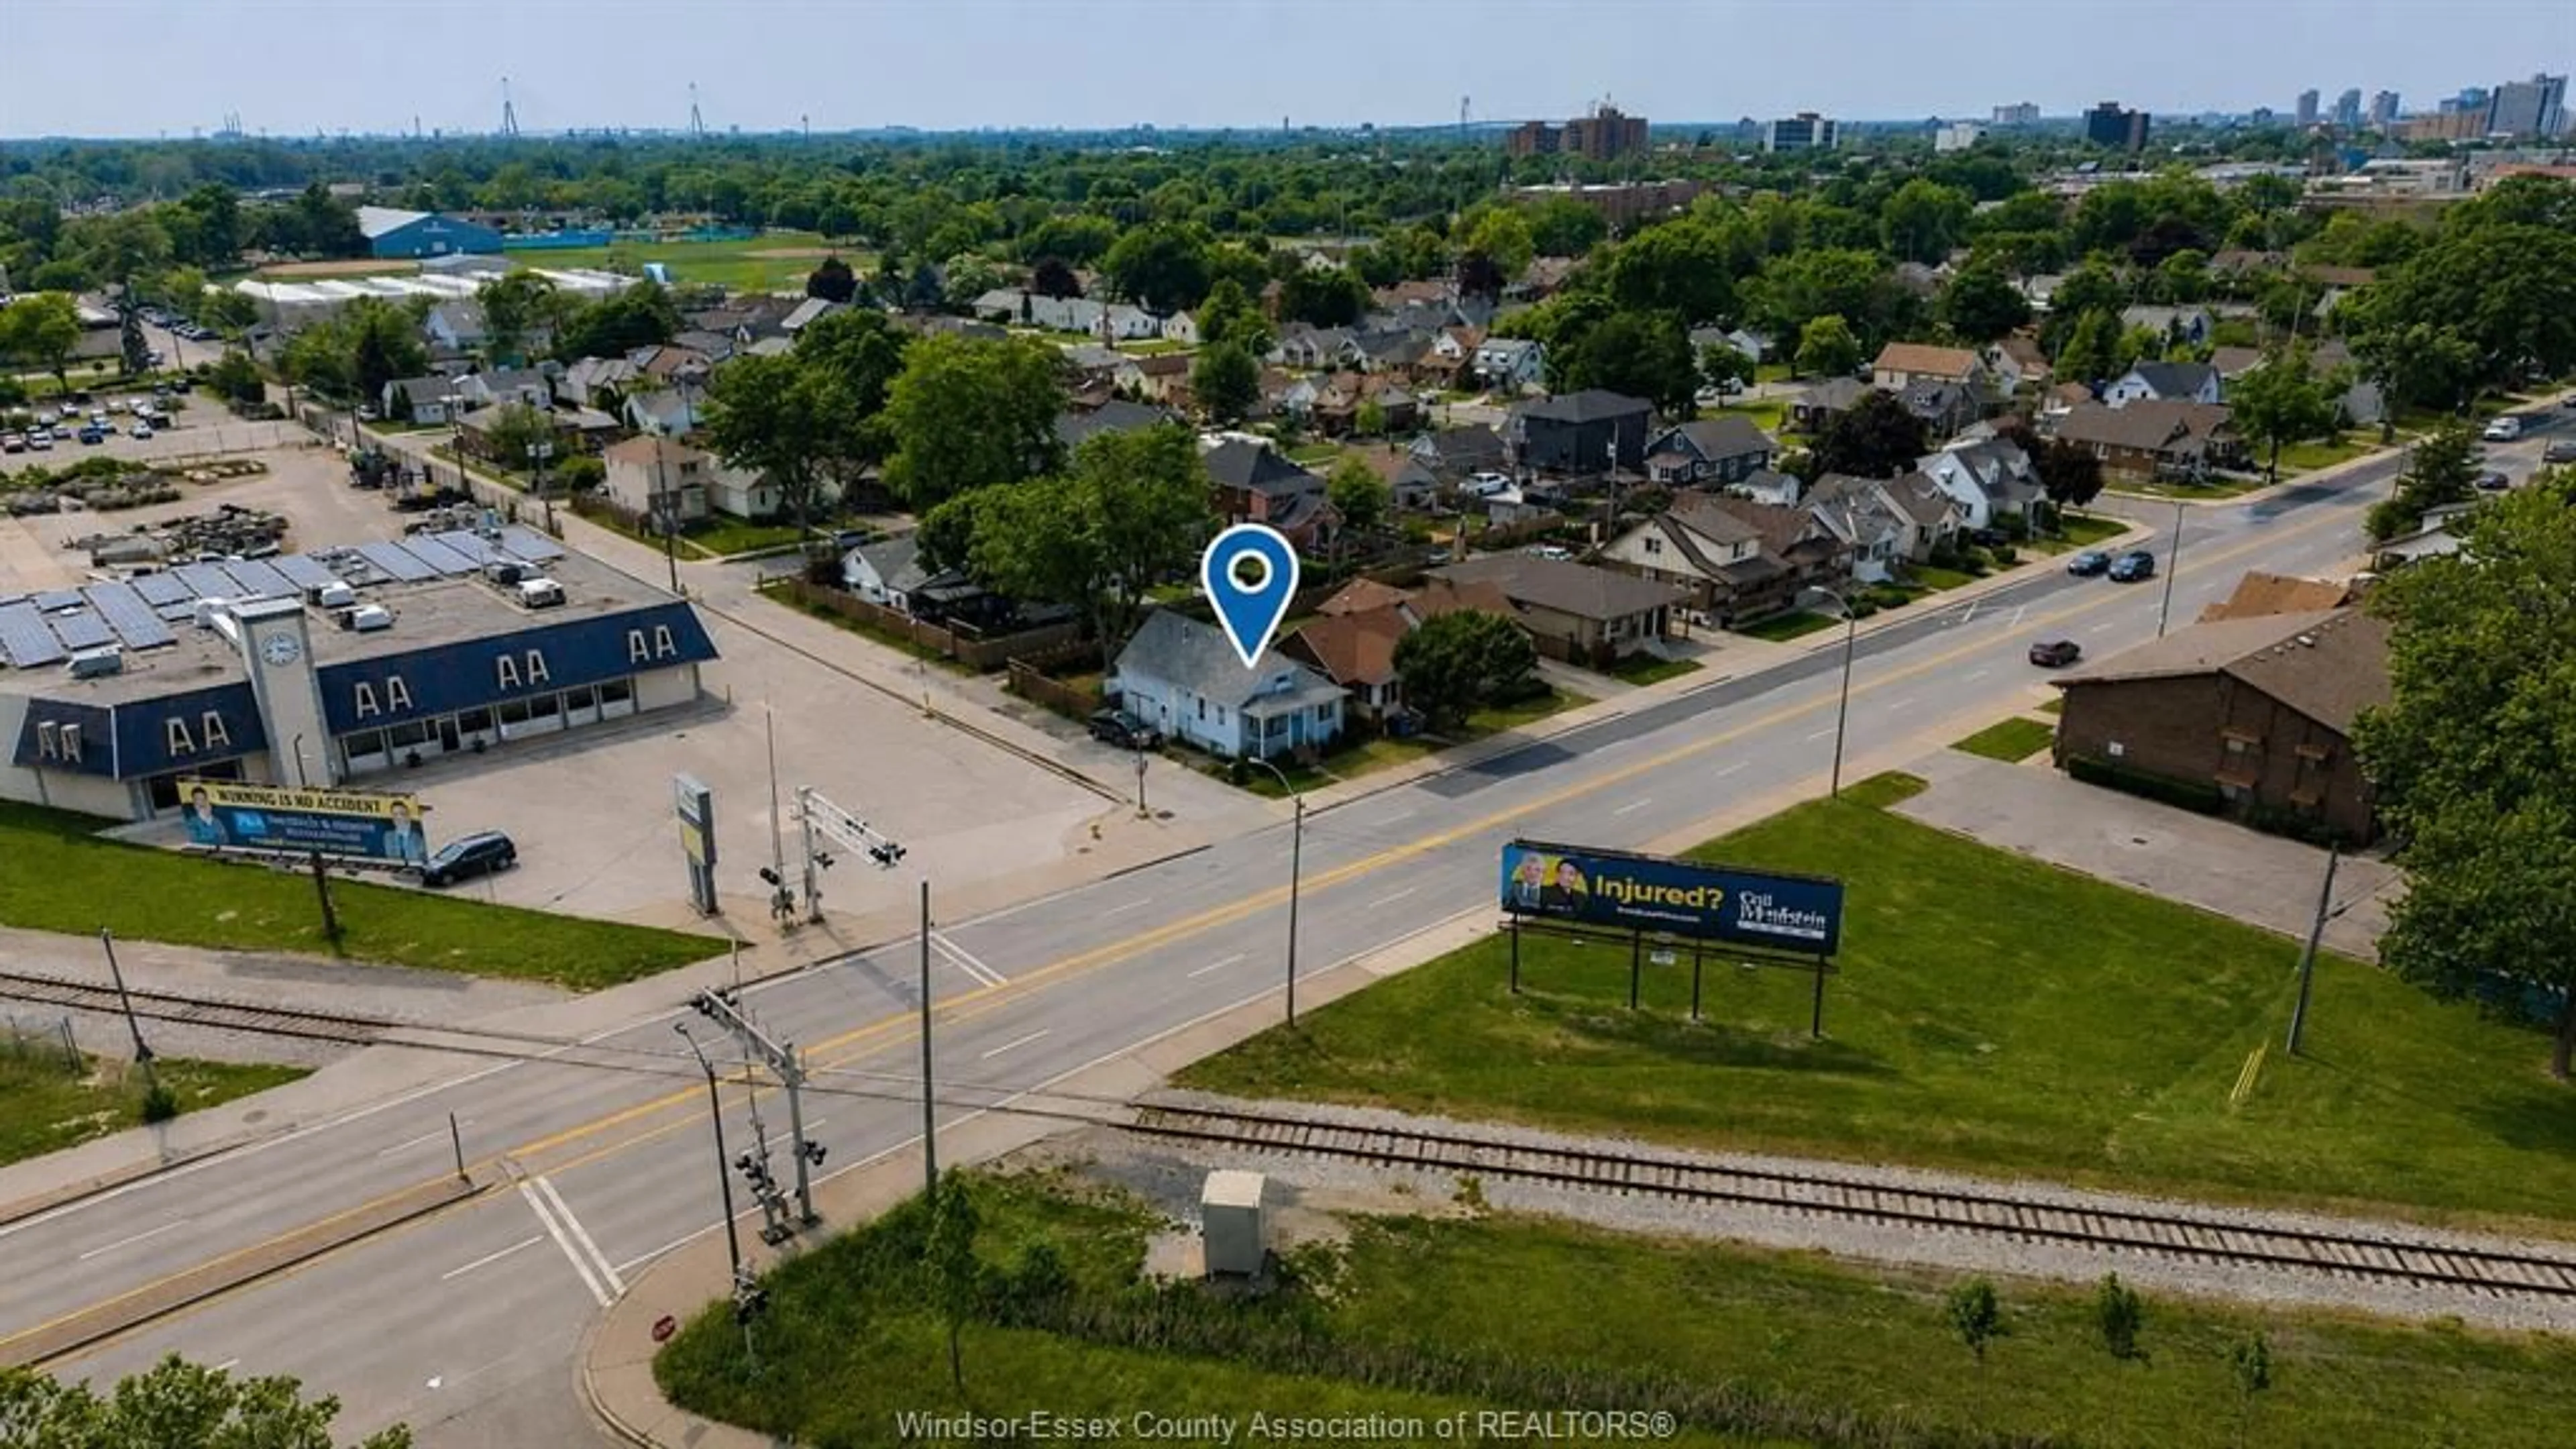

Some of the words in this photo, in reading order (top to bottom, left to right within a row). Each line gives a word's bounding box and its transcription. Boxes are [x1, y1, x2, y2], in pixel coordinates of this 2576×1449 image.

[628, 625, 678, 664] AA
[496, 649, 549, 690] AA
[354, 676, 413, 719] AA
[38, 719, 81, 763] AA
[167, 710, 231, 757] AA
[278, 794, 293, 806] IS
[317, 795, 381, 813] ACCIDENT
[1595, 874, 1724, 910] Injured?
